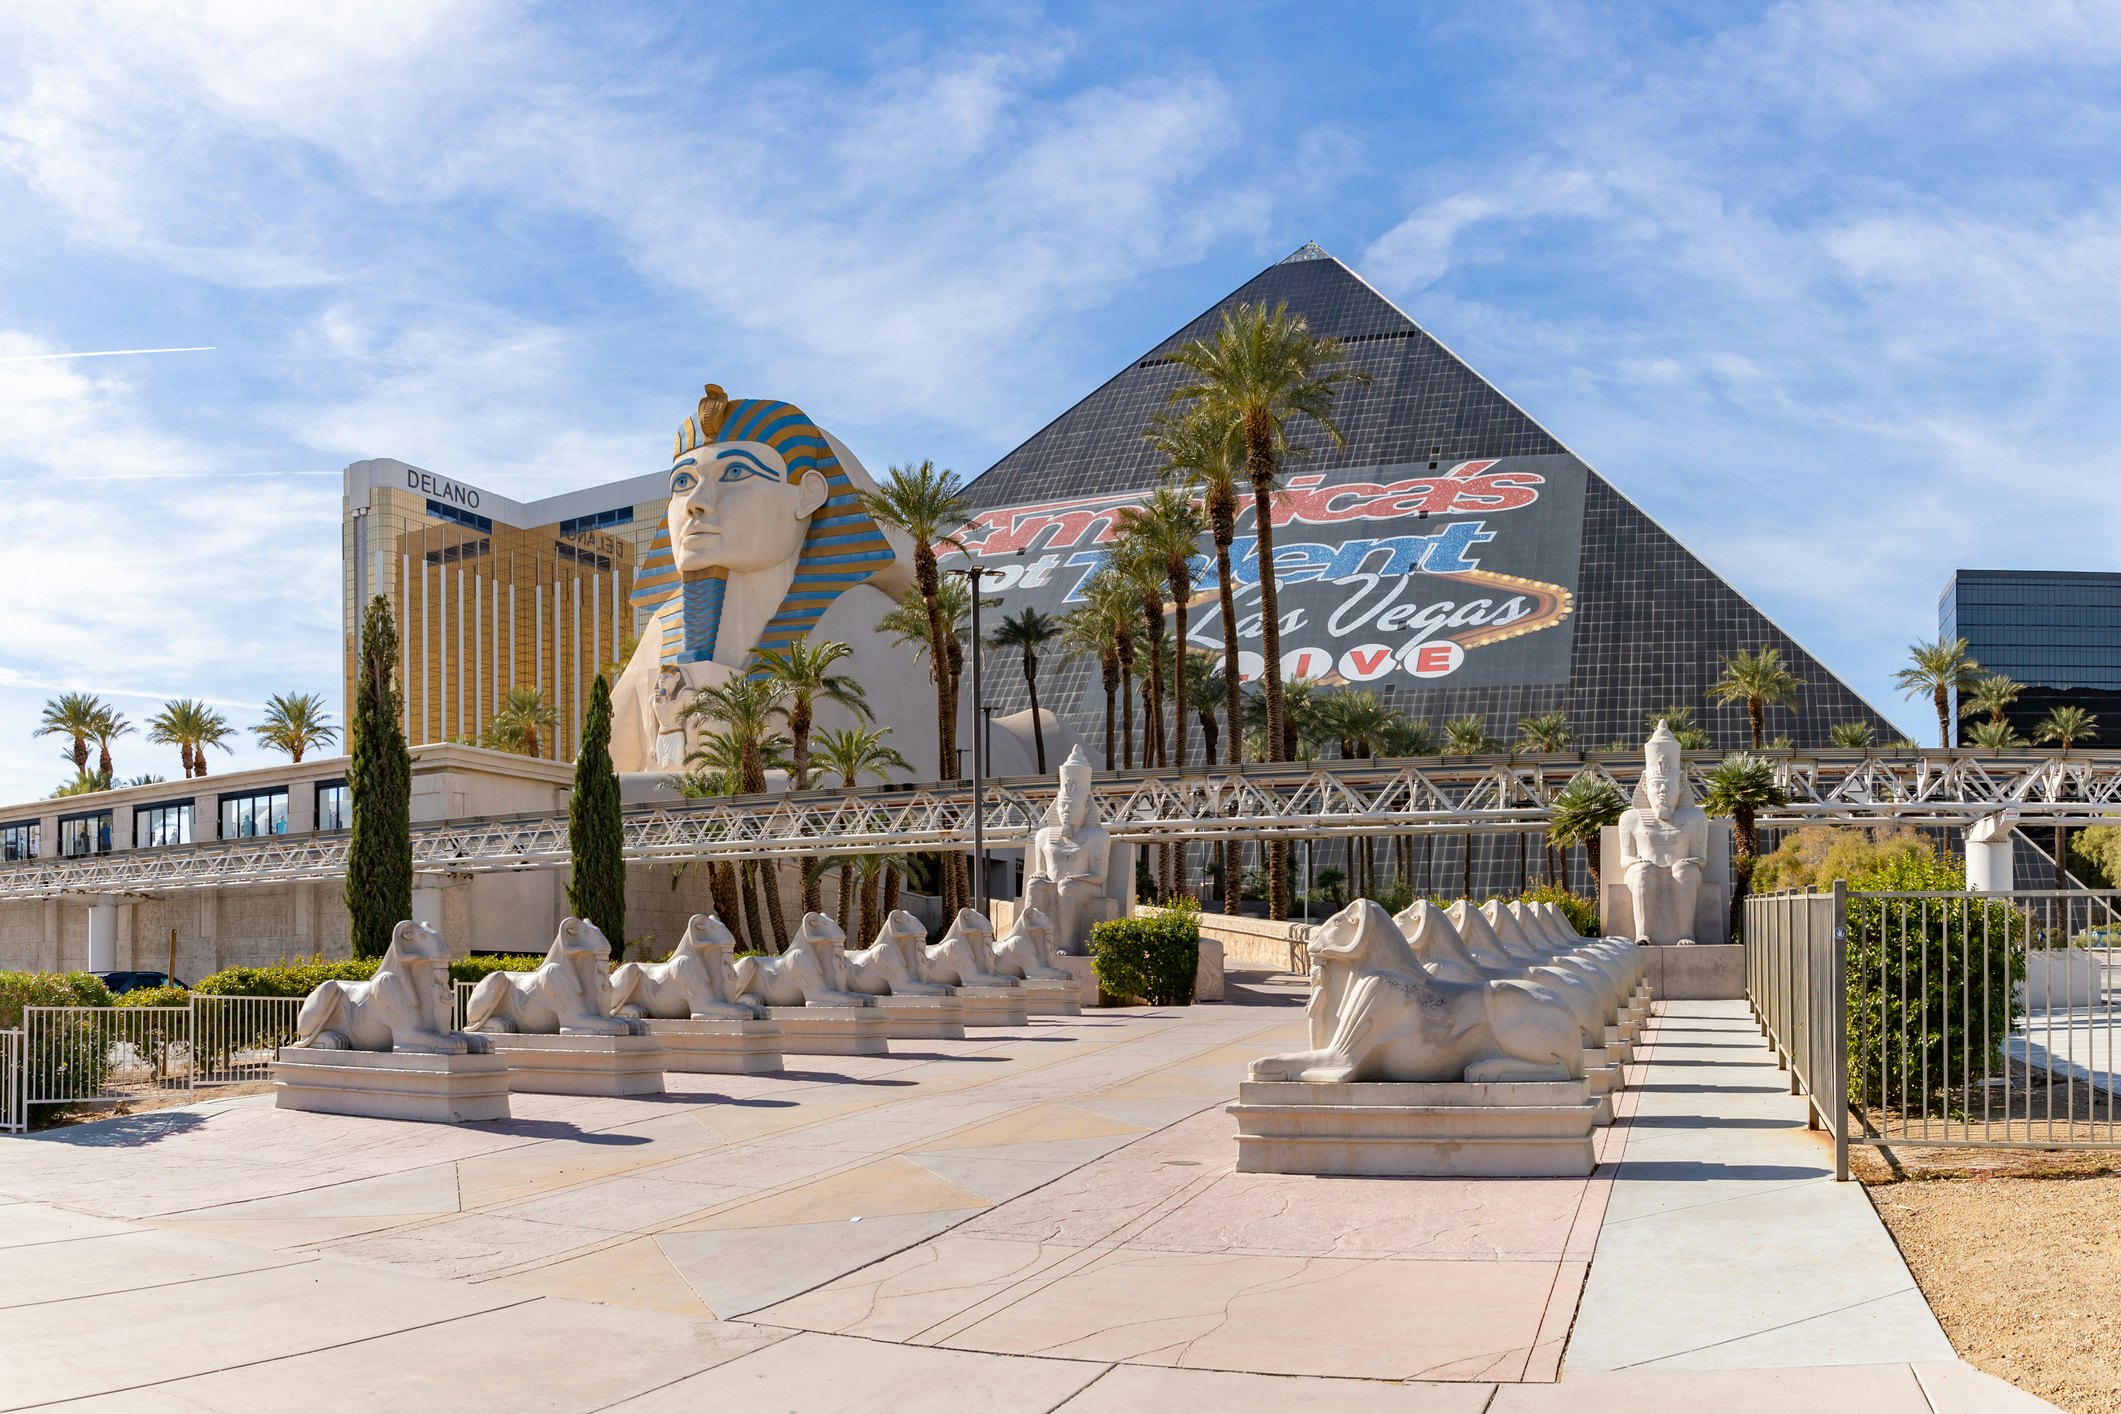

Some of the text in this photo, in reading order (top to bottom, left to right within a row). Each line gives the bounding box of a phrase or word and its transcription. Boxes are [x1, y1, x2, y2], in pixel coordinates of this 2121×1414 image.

[407, 469, 480, 508] DELANO
[929, 459, 1546, 561] Amica's
[945, 554, 1061, 593] ot
[1170, 572, 1532, 662] Las Vegas
[1228, 646, 1453, 682] IVE
